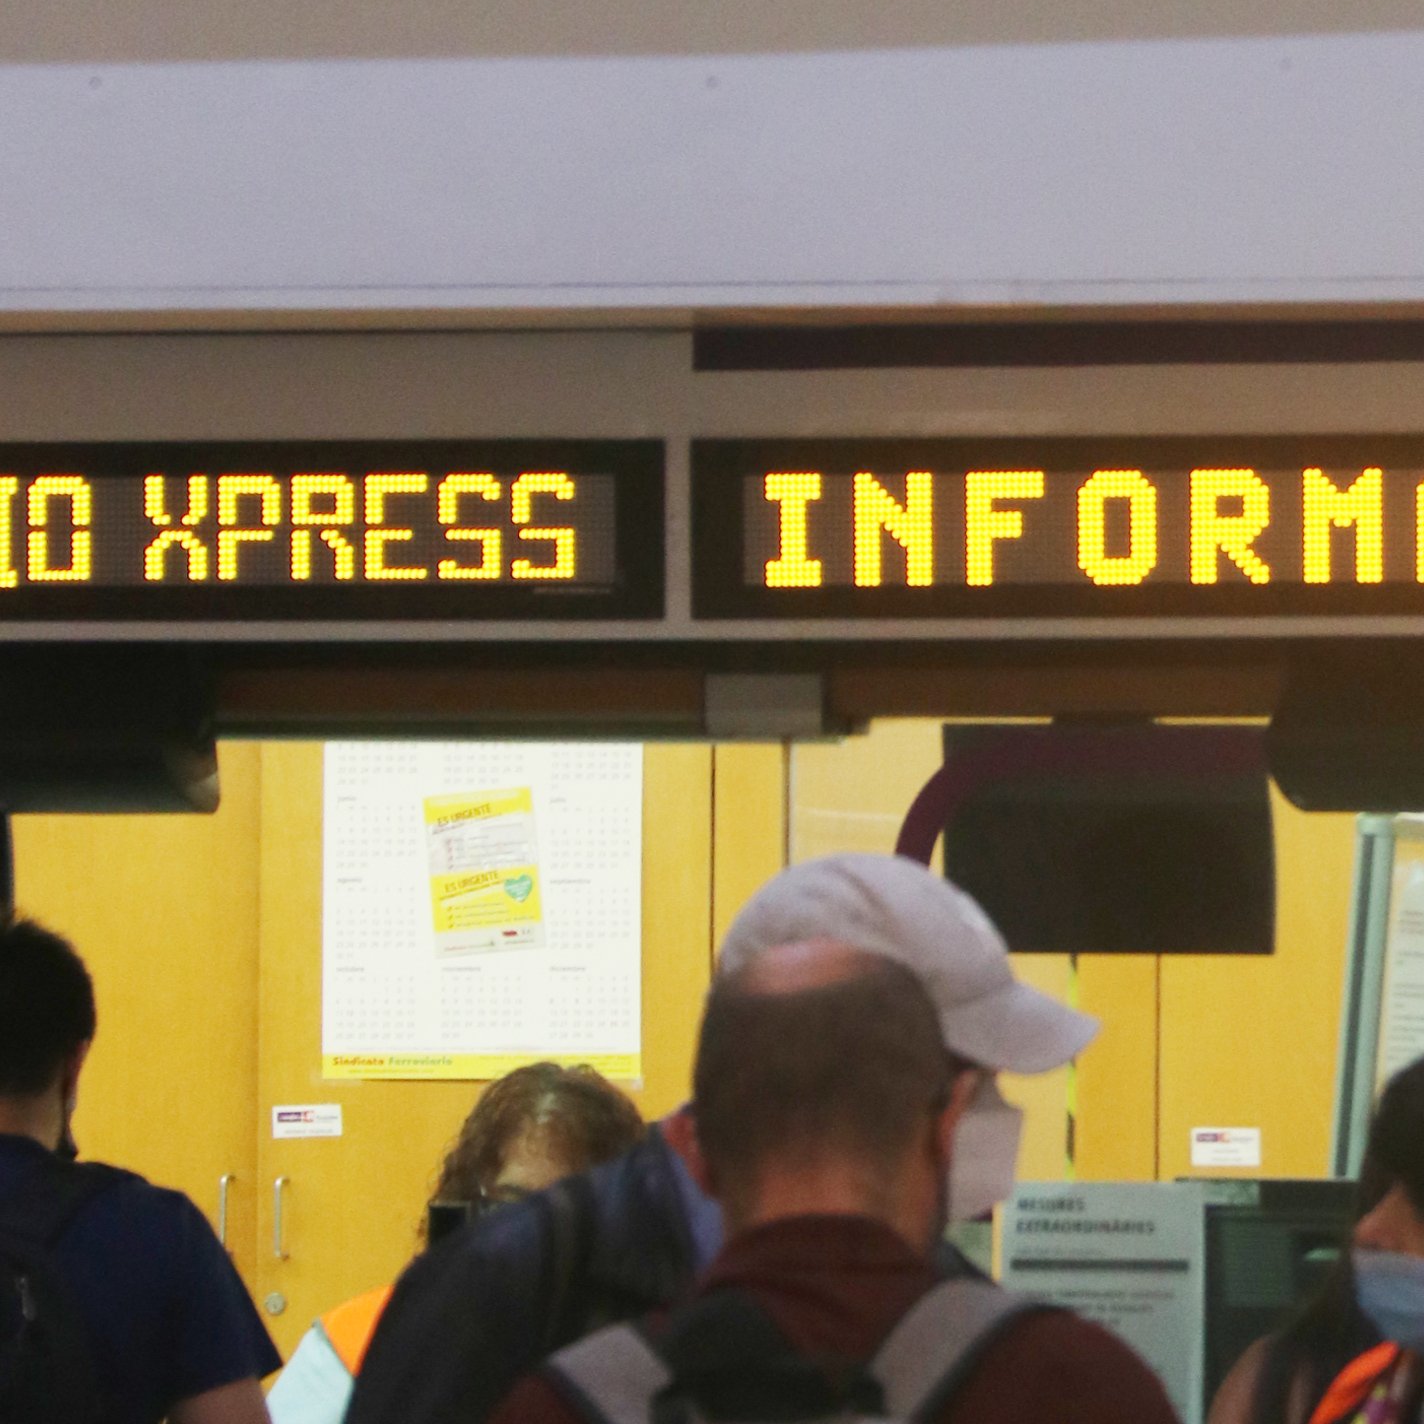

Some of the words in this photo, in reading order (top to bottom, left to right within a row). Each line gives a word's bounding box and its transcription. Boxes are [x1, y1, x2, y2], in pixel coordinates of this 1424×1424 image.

[144, 474, 575, 581] XPRESS
[450, 802, 492, 824] URGENTE
[457, 869, 500, 890] URGENTE
[332, 1056, 385, 1067] Sindicato
[387, 1056, 453, 1067] Ferroviario
